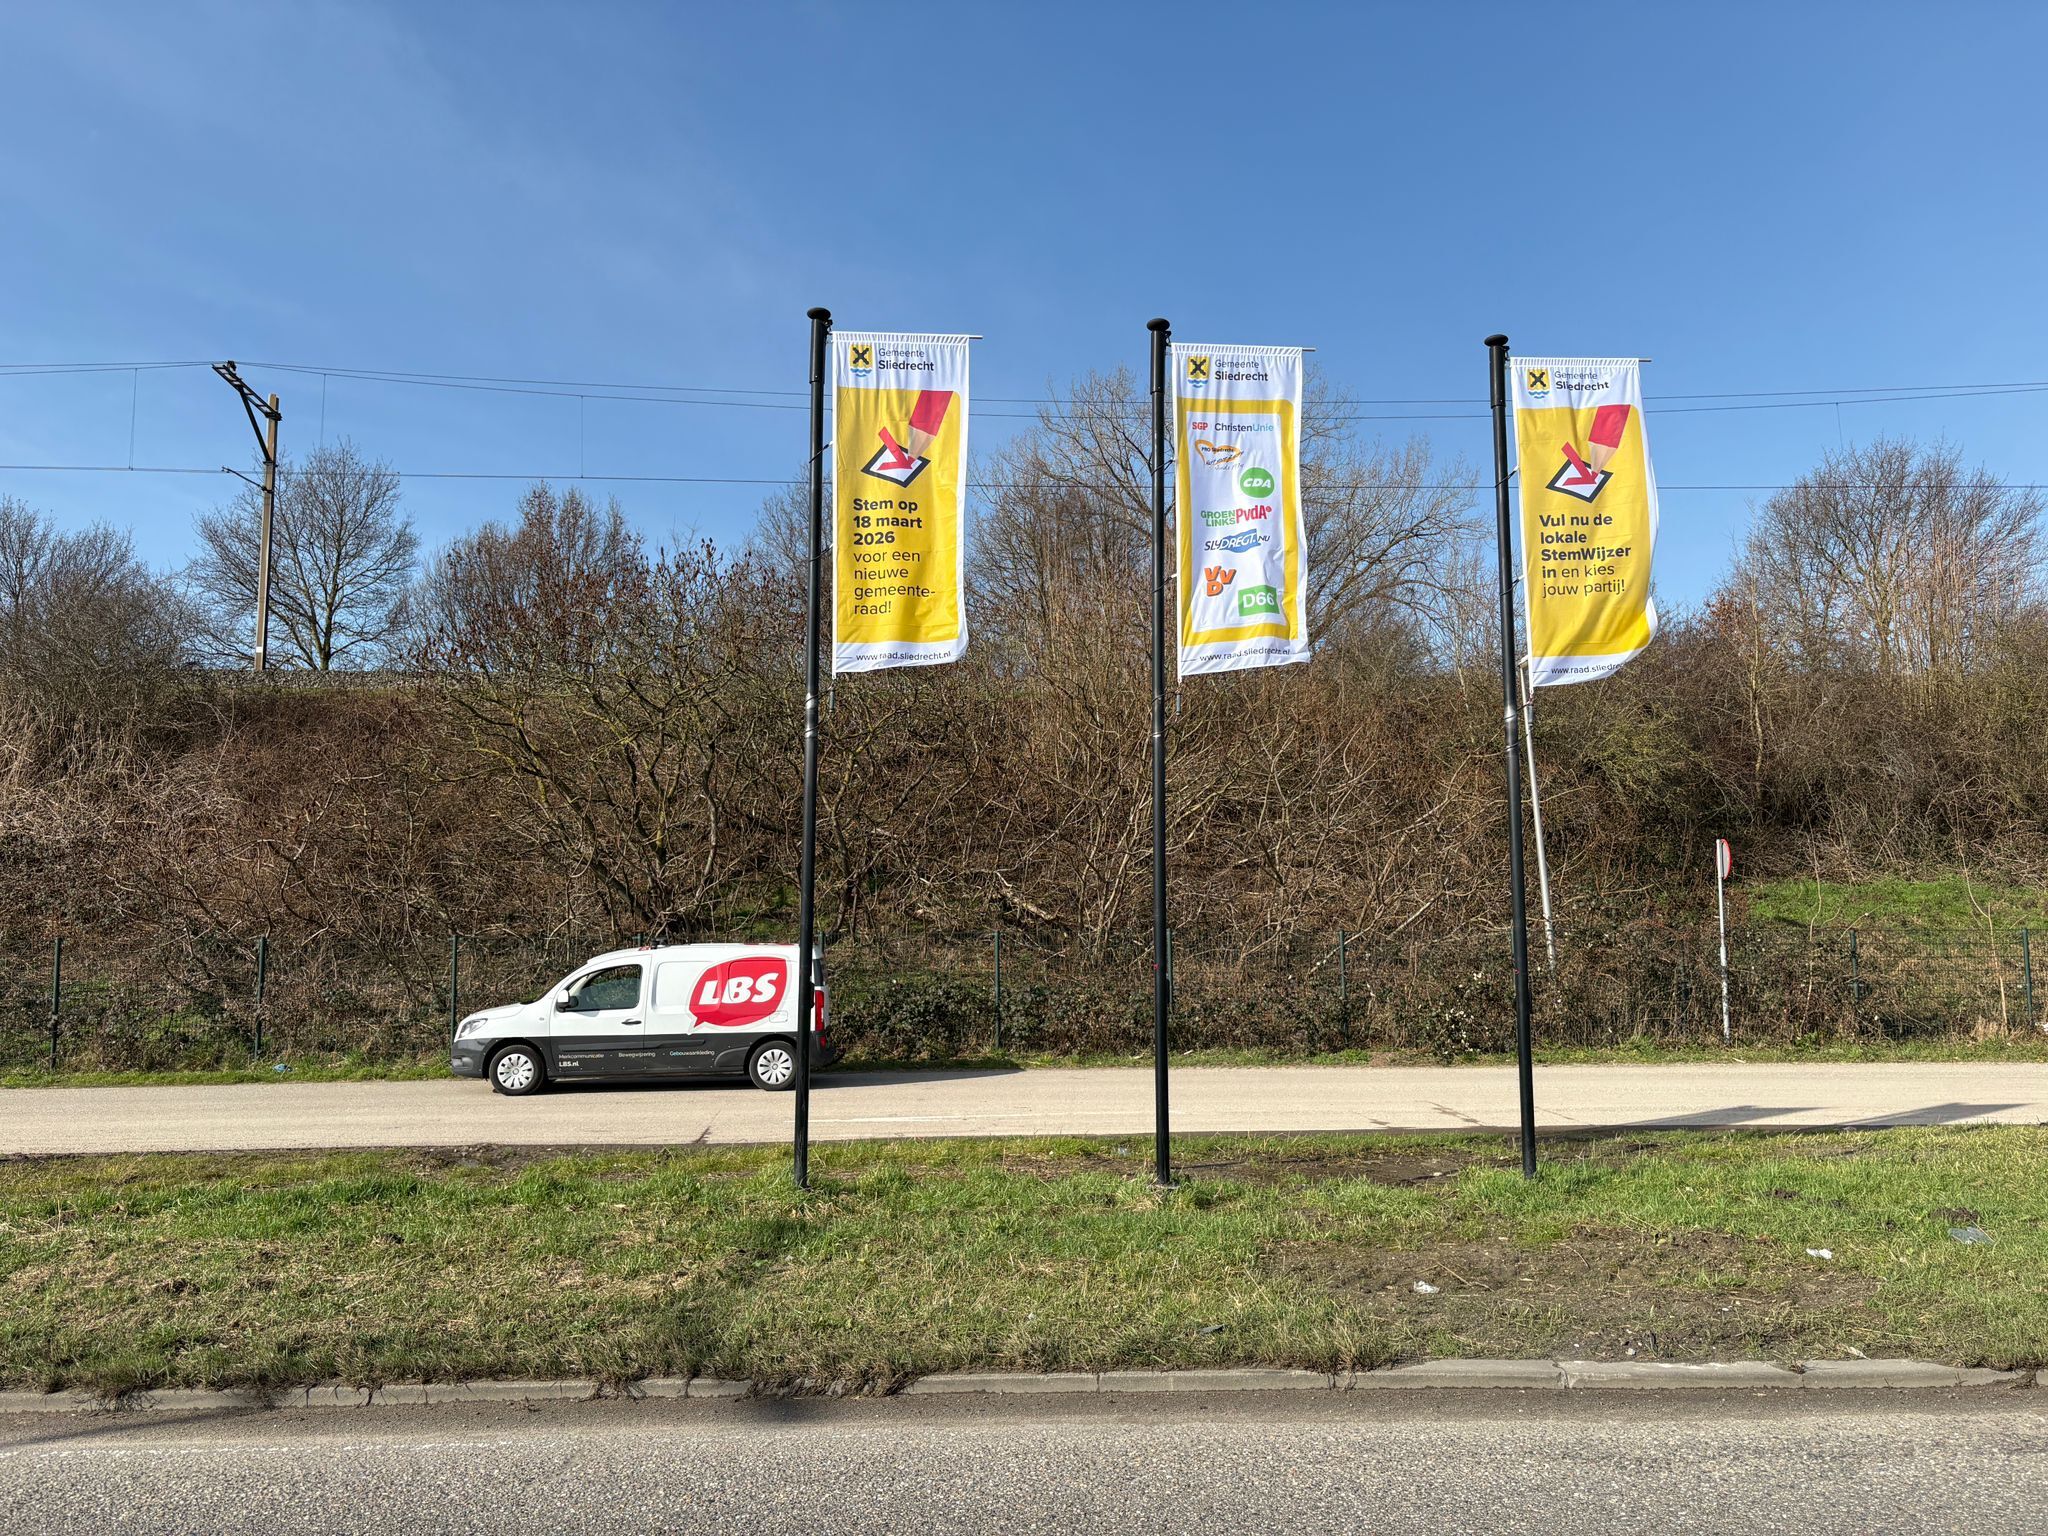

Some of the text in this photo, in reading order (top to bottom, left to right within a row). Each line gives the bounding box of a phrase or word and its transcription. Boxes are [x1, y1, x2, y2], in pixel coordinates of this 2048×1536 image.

[878, 348, 925, 357] Gemeente
[878, 359, 935, 371] Sliedrecht
[1214, 359, 1260, 369] Gemeente
[1214, 371, 1269, 381] Sliedrecht
[1554, 371, 1598, 380] Gemeente
[1555, 381, 1610, 391] Sliedrecht
[1192, 421, 1209, 431] SGP
[1214, 422, 1275, 432] ChristenUnie
[1243, 478, 1272, 488] CDA
[853, 498, 918, 513] Stem op
[1200, 510, 1236, 519] GROEN
[1235, 505, 1268, 524] PvdA
[1539, 513, 1613, 527] Vul nu de
[853, 516, 923, 529] 18 maart
[1205, 518, 1236, 527] LINKS
[853, 531, 895, 546] 2026
[1540, 531, 1588, 544] lokale
[853, 551, 920, 563] voor een
[1541, 546, 1631, 562] StemWijzer
[854, 567, 909, 580] nieuwe
[1542, 564, 1615, 579] in en kies
[854, 585, 936, 600] gemeente-
[1542, 579, 1625, 598] jouw partij!
[1242, 591, 1275, 609] D66
[854, 601, 892, 615] raad!
[856, 650, 951, 661] wwwraad.sliedrecht.nl
[698, 972, 780, 1006] LBS
